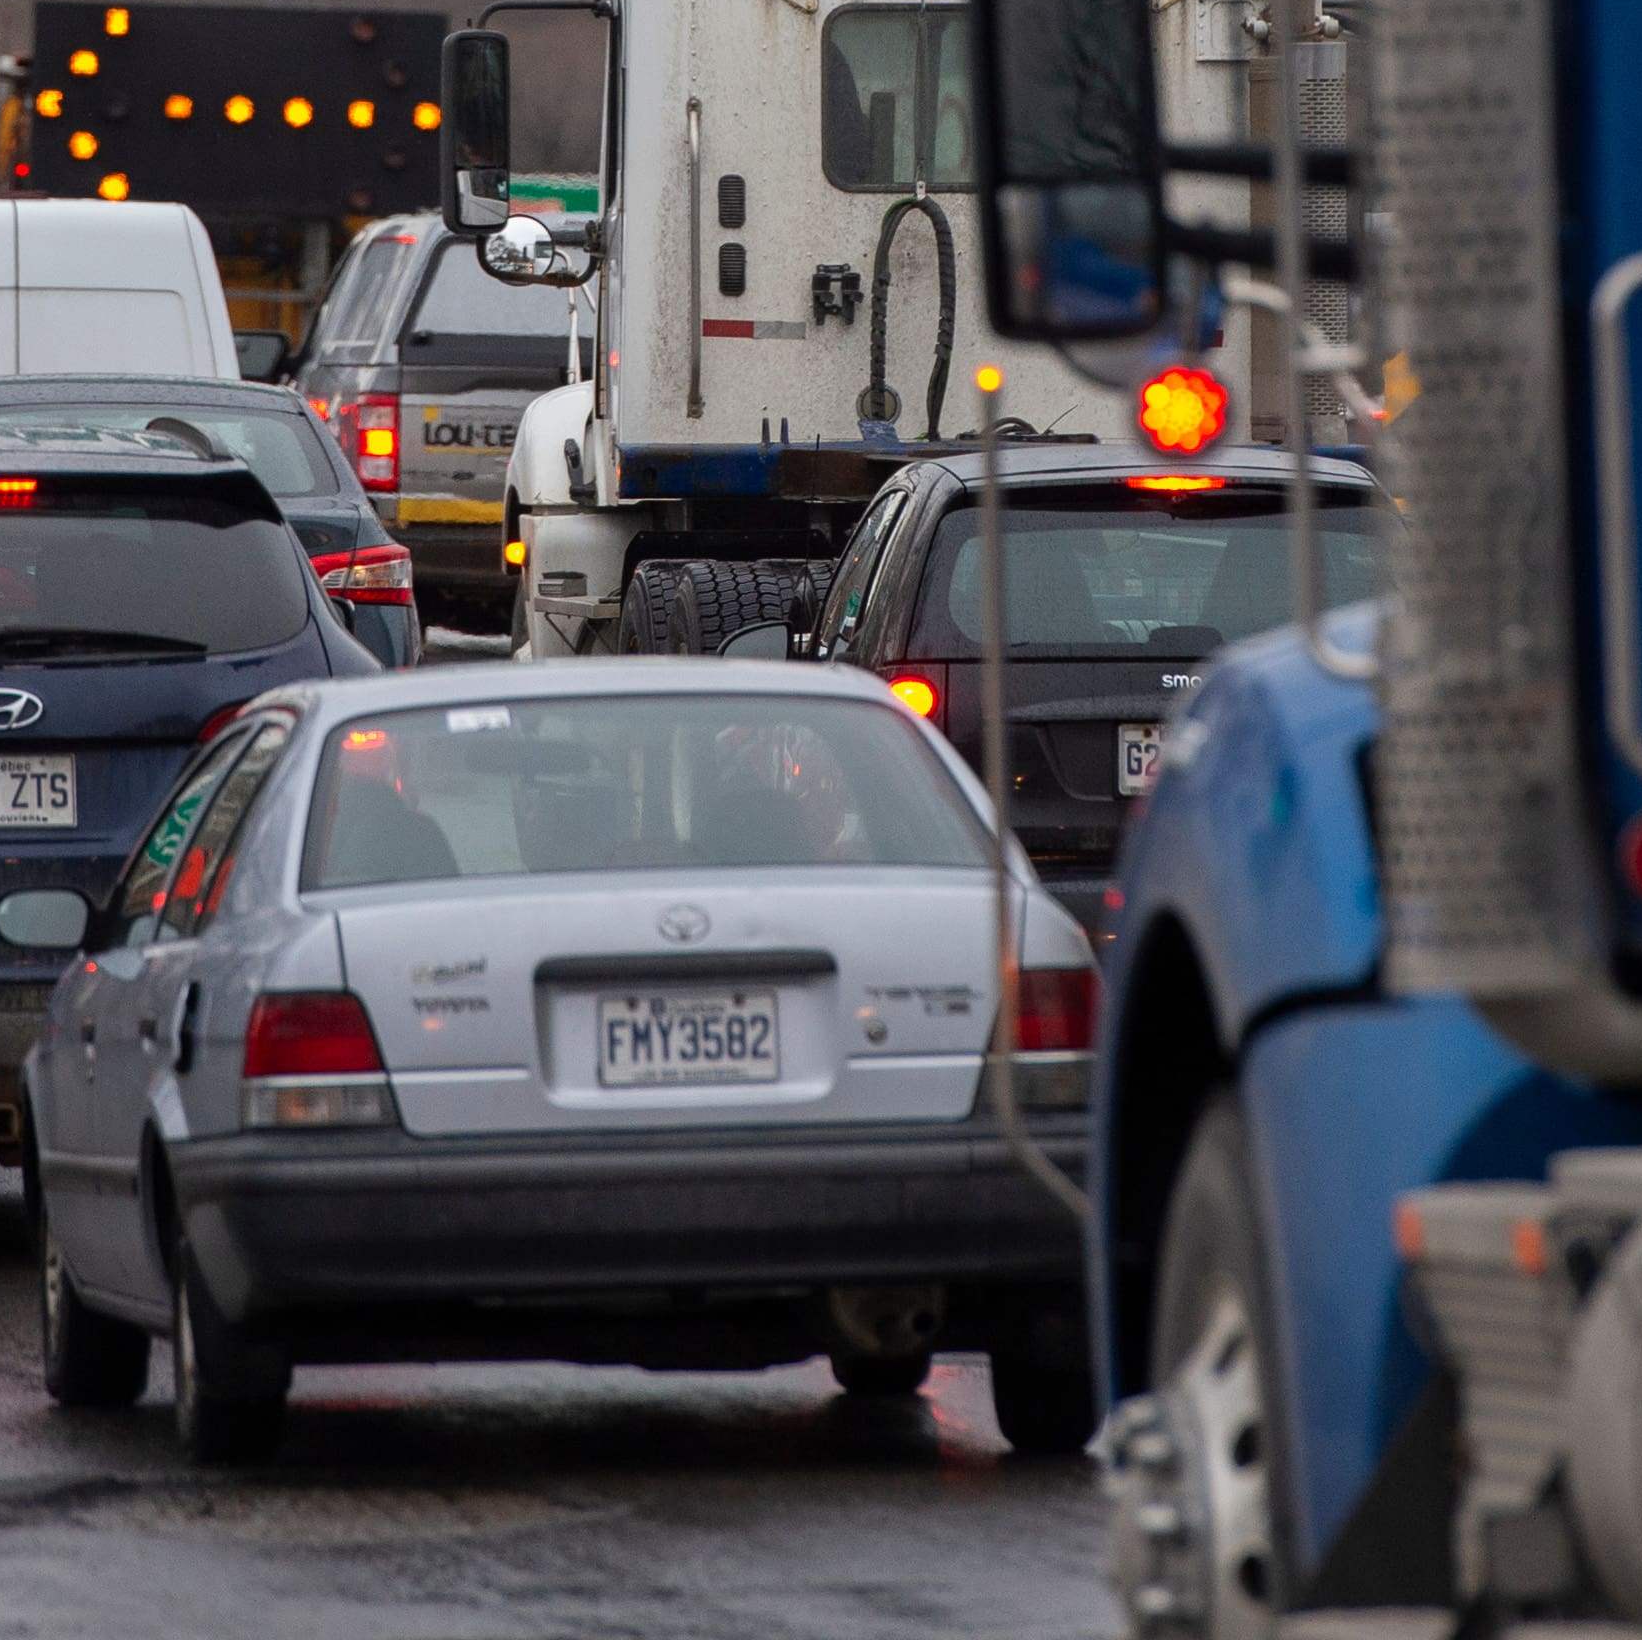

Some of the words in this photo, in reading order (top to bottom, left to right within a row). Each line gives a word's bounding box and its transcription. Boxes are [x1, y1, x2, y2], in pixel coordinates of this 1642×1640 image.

[424, 421, 517, 448] LOU-TE
[1126, 742, 1160, 776] G2
[9, 772, 69, 809] ZTS
[607, 1014, 772, 1065] FMY3582
